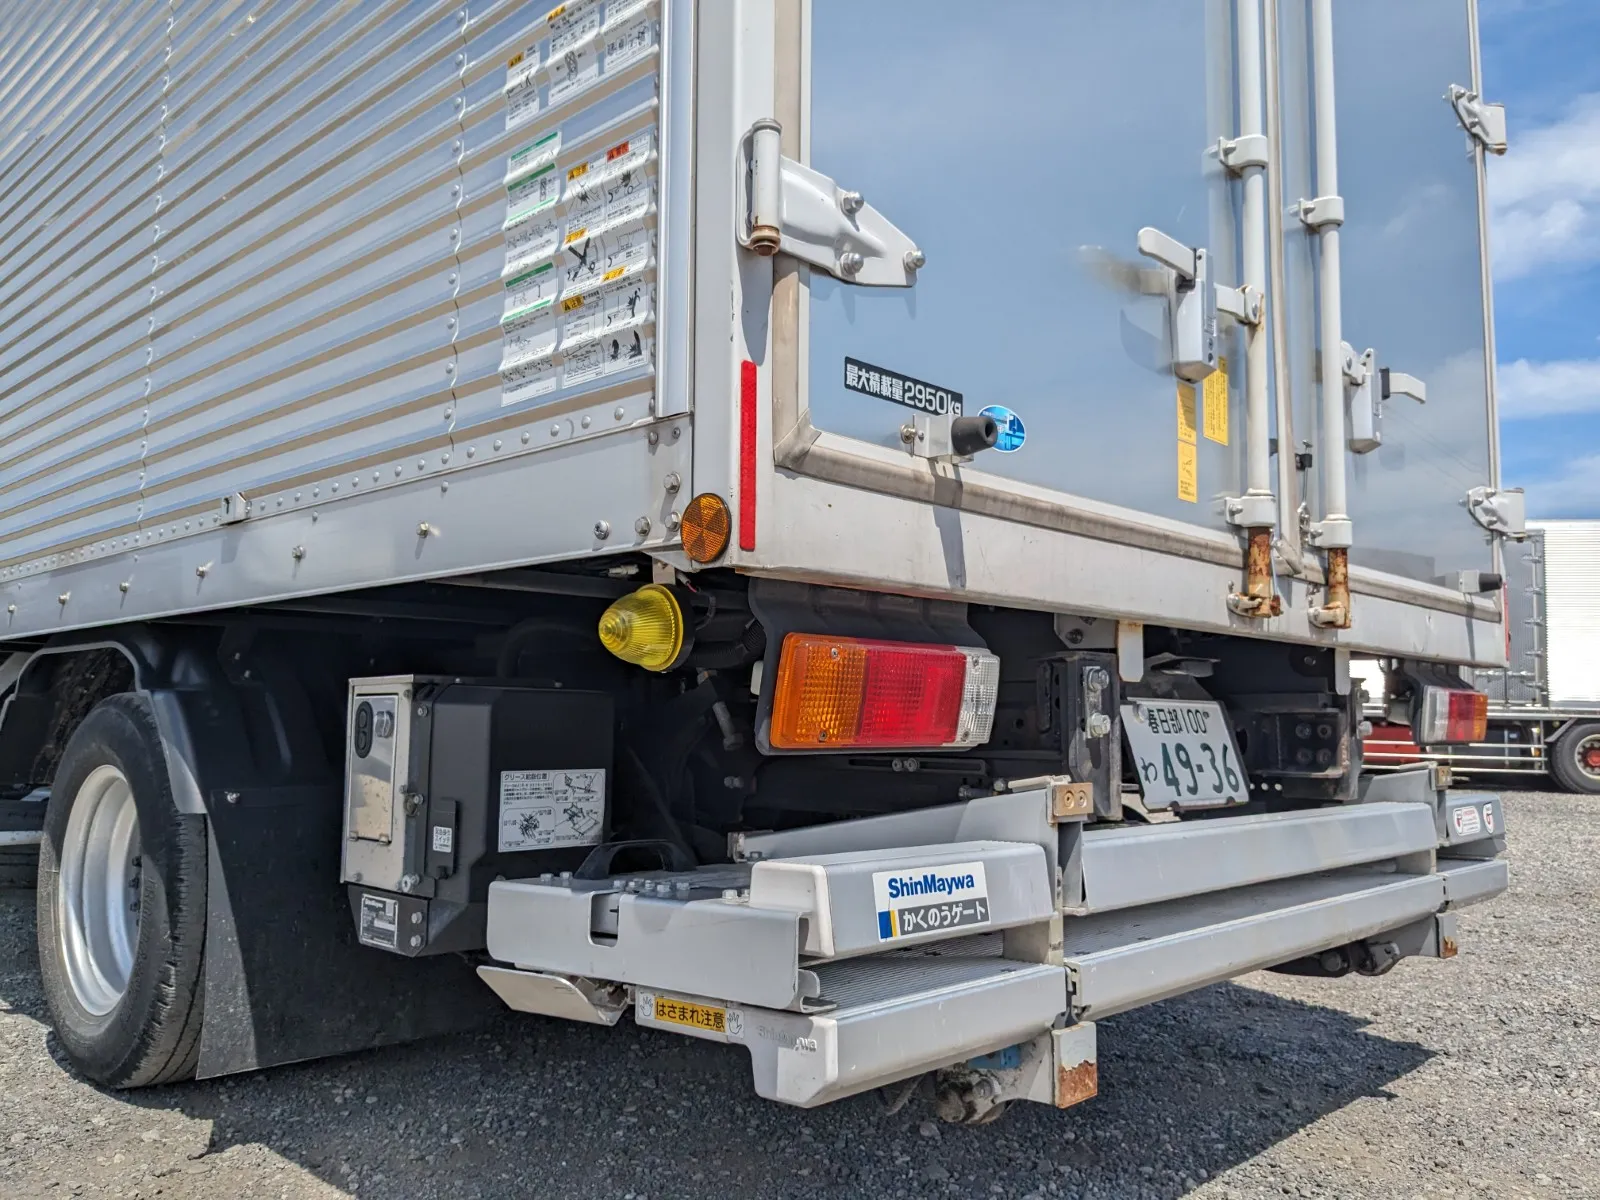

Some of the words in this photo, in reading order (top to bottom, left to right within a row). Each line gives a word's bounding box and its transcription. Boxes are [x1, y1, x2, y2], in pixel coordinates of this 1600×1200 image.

[1140, 756, 1158, 785] わ
[1161, 742, 1240, 797] 49-36
[888, 873, 975, 899] ShinMaywa
[902, 901, 986, 932] かくのうゲート
[656, 1000, 726, 1030] はさまれ注意
